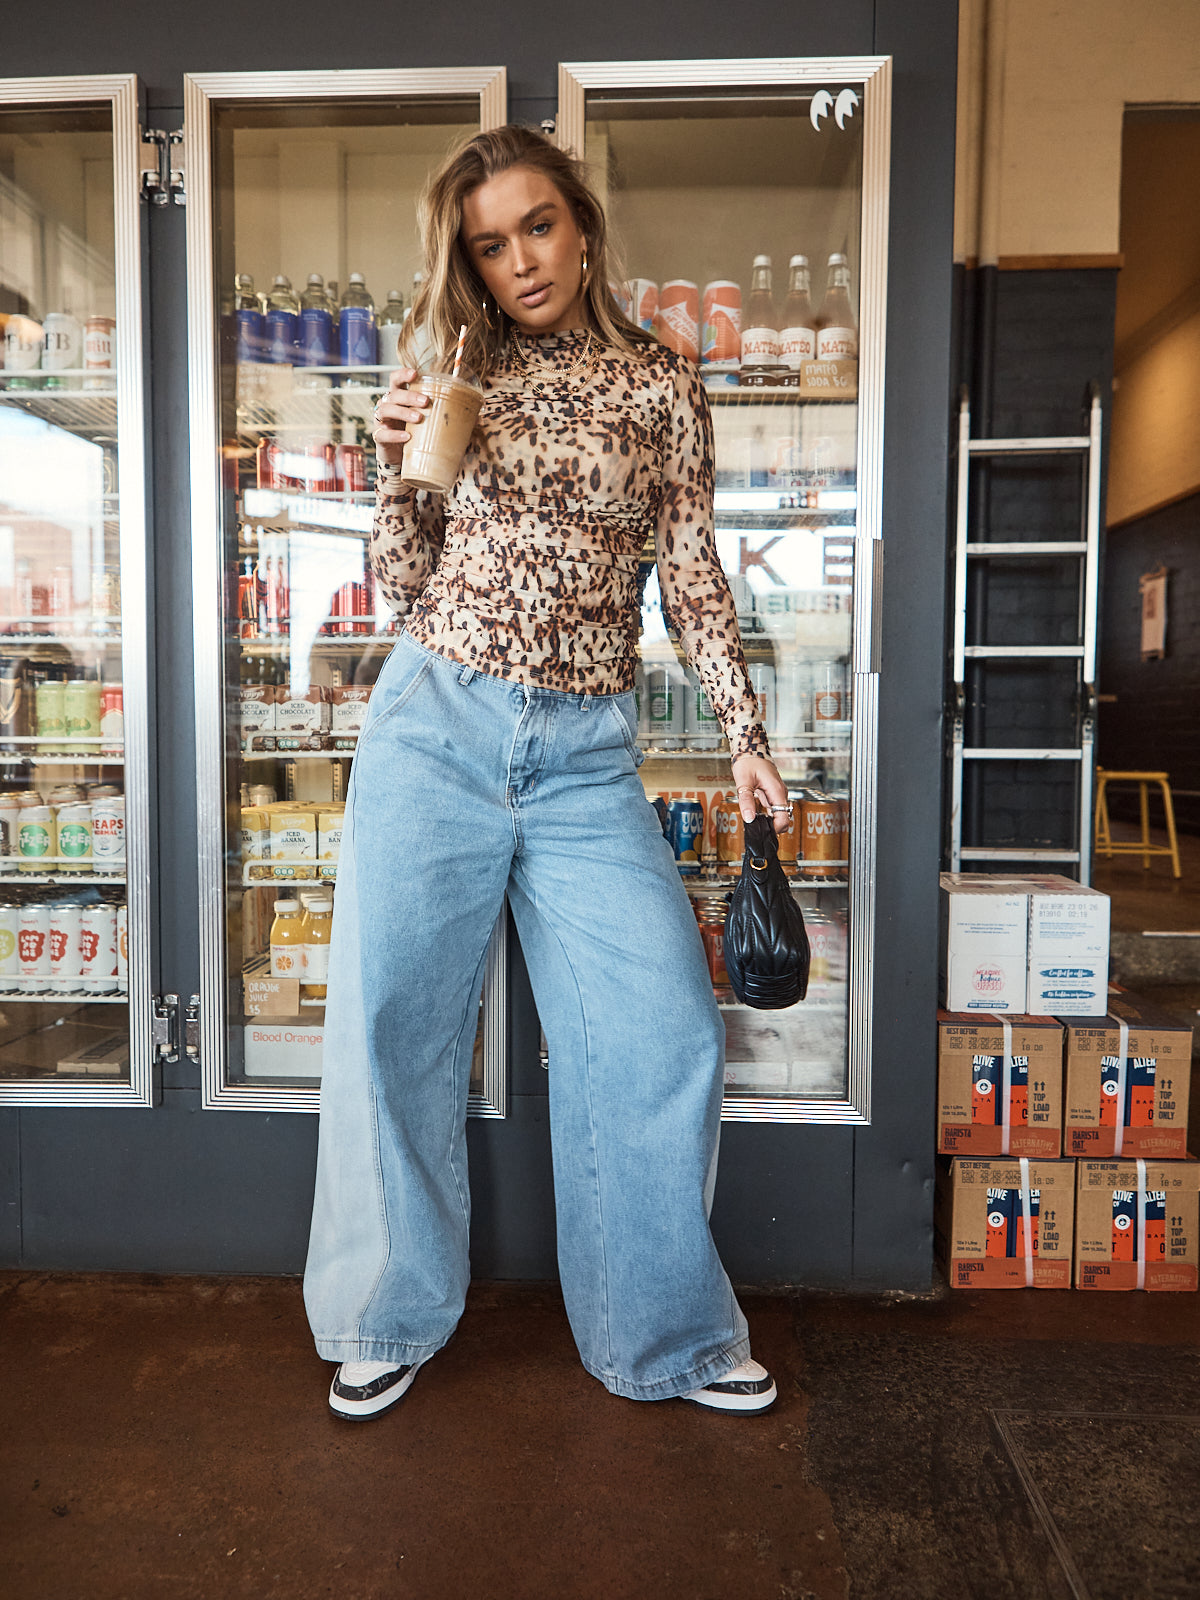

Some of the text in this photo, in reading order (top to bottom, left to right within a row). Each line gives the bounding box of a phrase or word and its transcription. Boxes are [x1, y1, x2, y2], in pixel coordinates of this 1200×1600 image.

[253, 1032, 323, 1045] Blood Orange
[1133, 1057, 1156, 1069] ALTER
[1033, 1093, 1046, 1101] TOP
[1160, 1091, 1172, 1099] TOP
[1033, 1103, 1049, 1111] LOAD
[1159, 1101, 1176, 1110] LOAD
[1033, 1113, 1049, 1122] ONLY
[1158, 1111, 1175, 1120] ONLY
[944, 1128, 971, 1137] BARISTA
[1072, 1131, 1099, 1140] BARISTA
[1072, 1140, 1084, 1149] OAT
[987, 1188, 1008, 1200] ATIVE
[1112, 1190, 1134, 1202] ATIVE
[1044, 1222, 1056, 1230] TOP
[1171, 1228, 1183, 1236] TOP
[1043, 1242, 1059, 1250] ONLY
[1171, 1238, 1187, 1246] LOAD
[1170, 1248, 1187, 1256] ONLY
[958, 1263, 984, 1271] BARISTA
[1084, 1266, 1110, 1275] BARISTA
[958, 1272, 970, 1280] OAT
[1083, 1275, 1096, 1283] OAT
